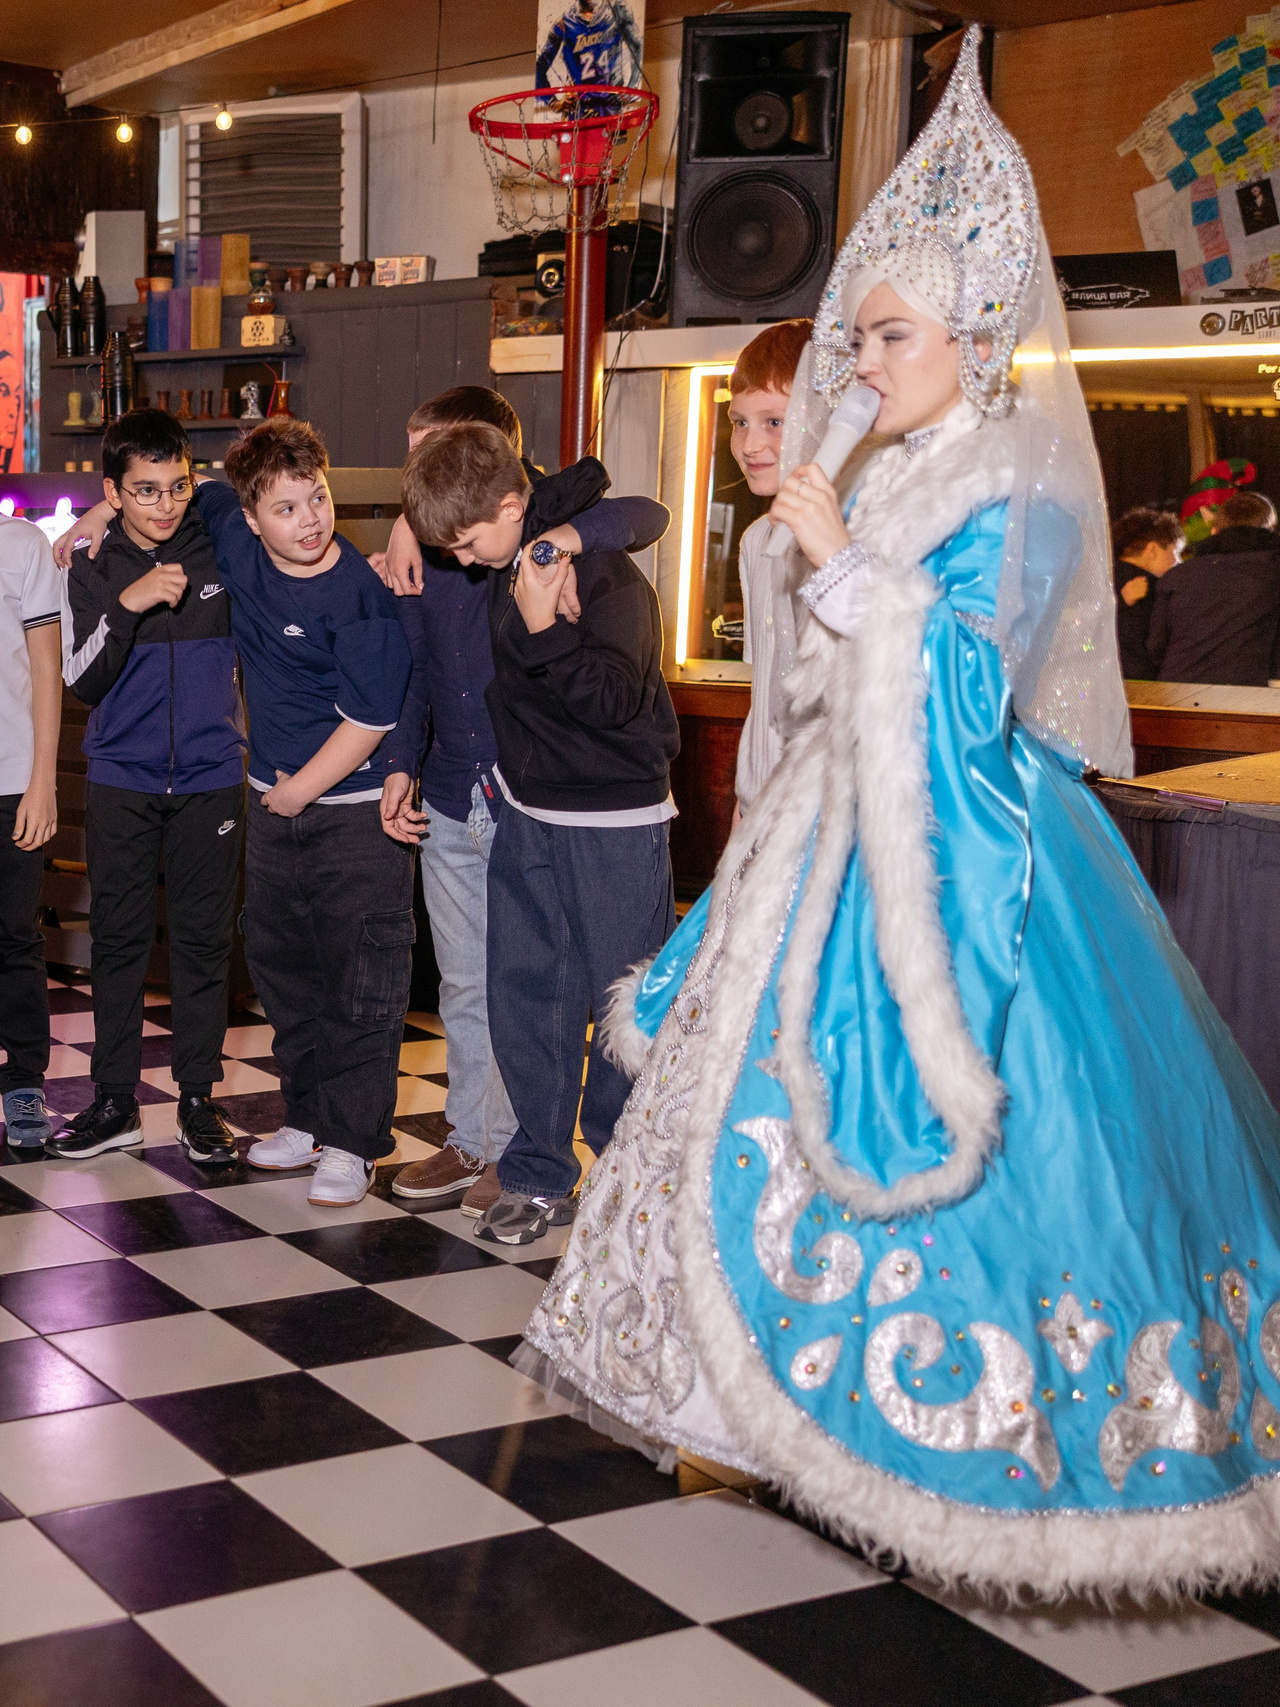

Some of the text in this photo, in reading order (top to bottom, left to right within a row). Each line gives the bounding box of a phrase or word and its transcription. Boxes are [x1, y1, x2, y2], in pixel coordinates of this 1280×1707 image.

[580, 50, 610, 80] 24
[1109, 291, 1131, 300] BAR
[1228, 308, 1280, 335] PART
[203, 584, 220, 594] NIKE
